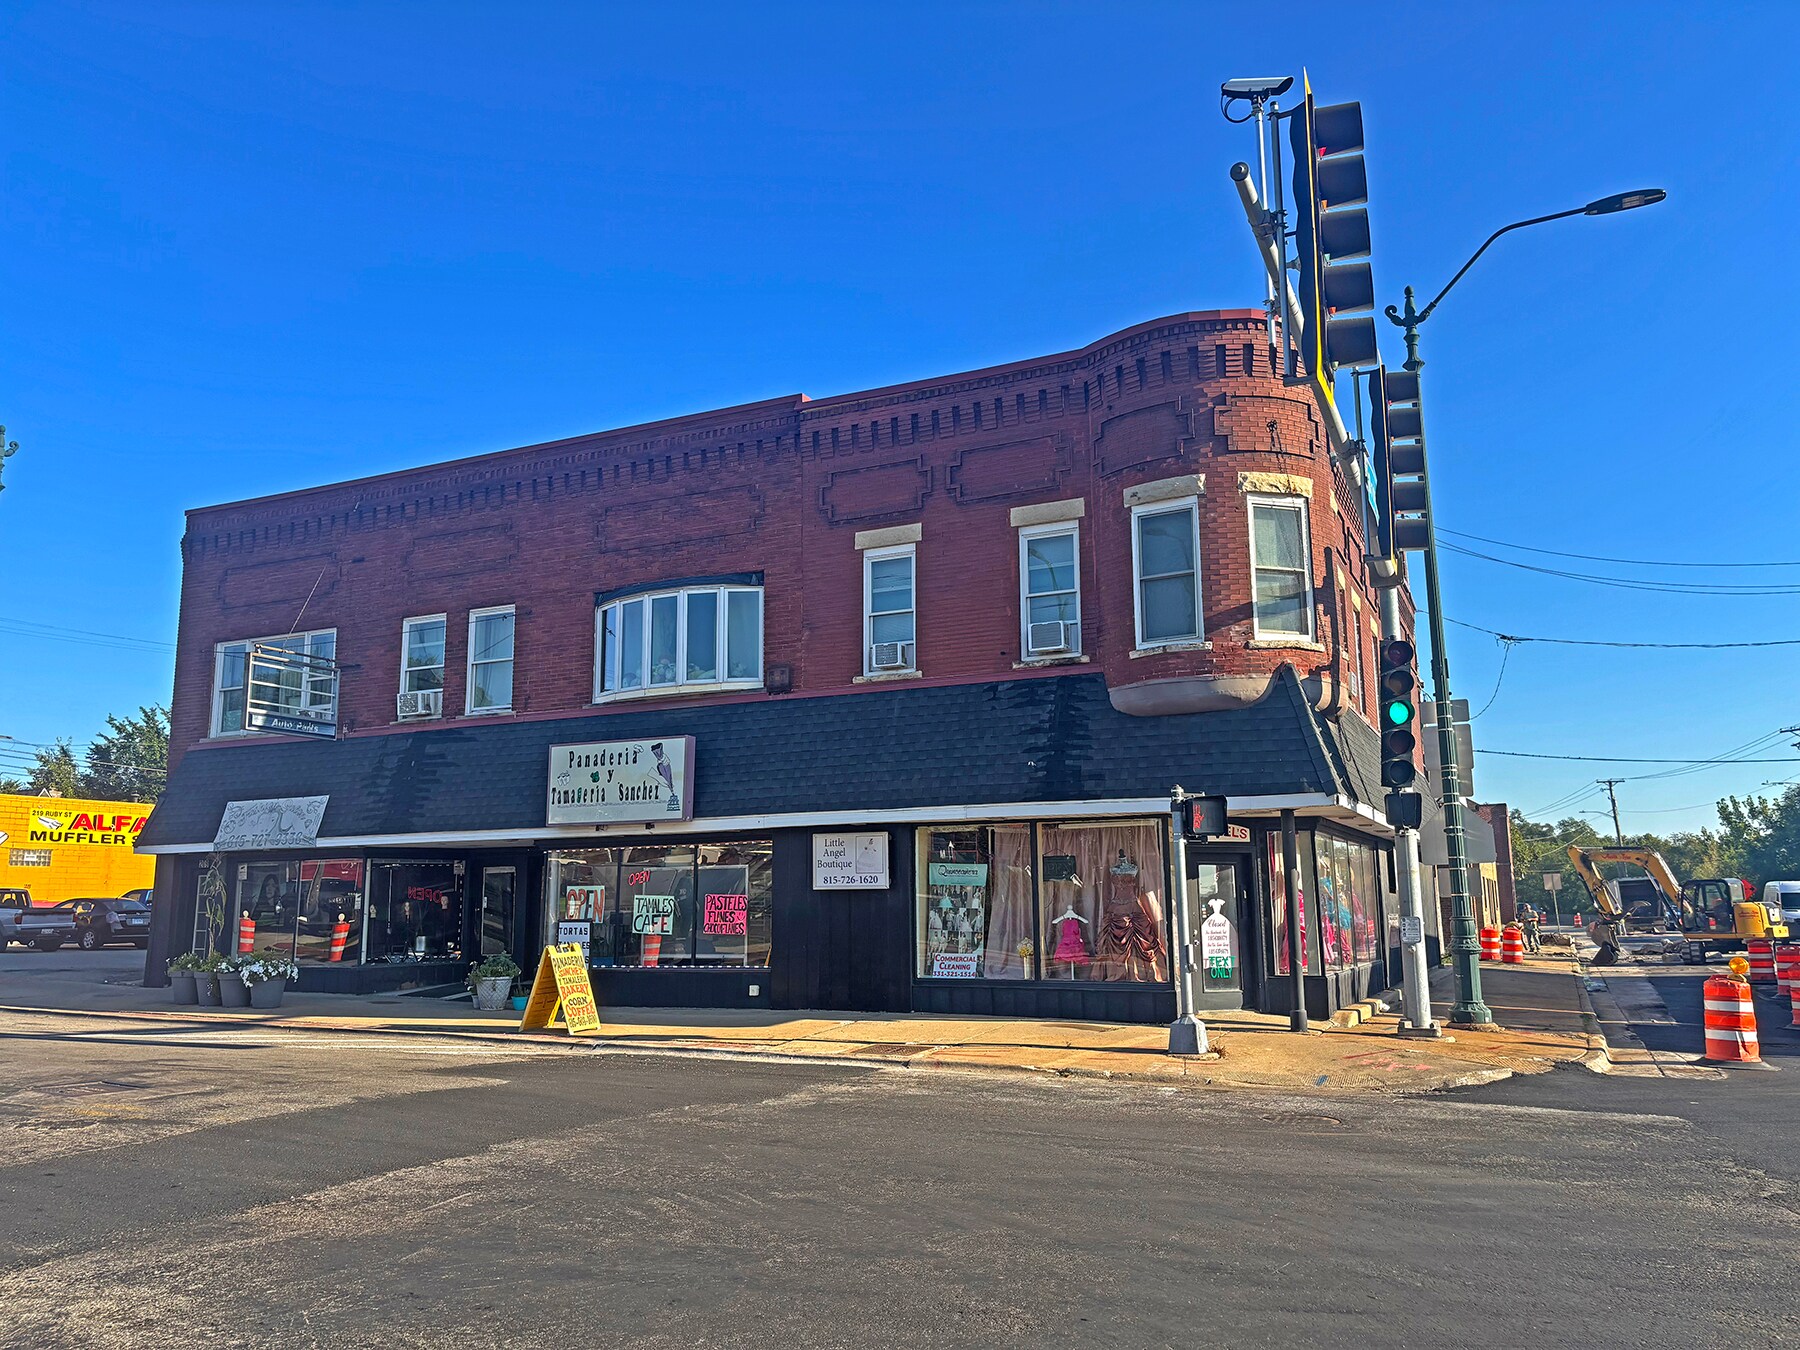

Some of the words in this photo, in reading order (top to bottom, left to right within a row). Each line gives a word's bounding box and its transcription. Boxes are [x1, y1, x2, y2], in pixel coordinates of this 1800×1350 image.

[607, 769, 615, 783] y
[618, 780, 660, 801] Sanchez
[32, 809, 44, 817] 219
[30, 830, 126, 845] MUFFLER
[824, 837, 845, 848] Little
[823, 847, 846, 860] Angel
[817, 859, 853, 871] Boutique
[629, 870, 651, 887] OPEN
[823, 875, 879, 885] 815-726-1620
[635, 897, 675, 914] TAMALES
[705, 894, 748, 911] PASTELES
[559, 927, 588, 936] TORTAS
[935, 953, 977, 963] COMMERCIAL
[1208, 956, 1236, 968] TEXT
[939, 961, 971, 971] CLEANING
[1210, 967, 1234, 979] ONLY
[560, 983, 591, 1000] BAKERY
[568, 996, 589, 1007] CORN
[565, 1000, 596, 1018] COFFEE
